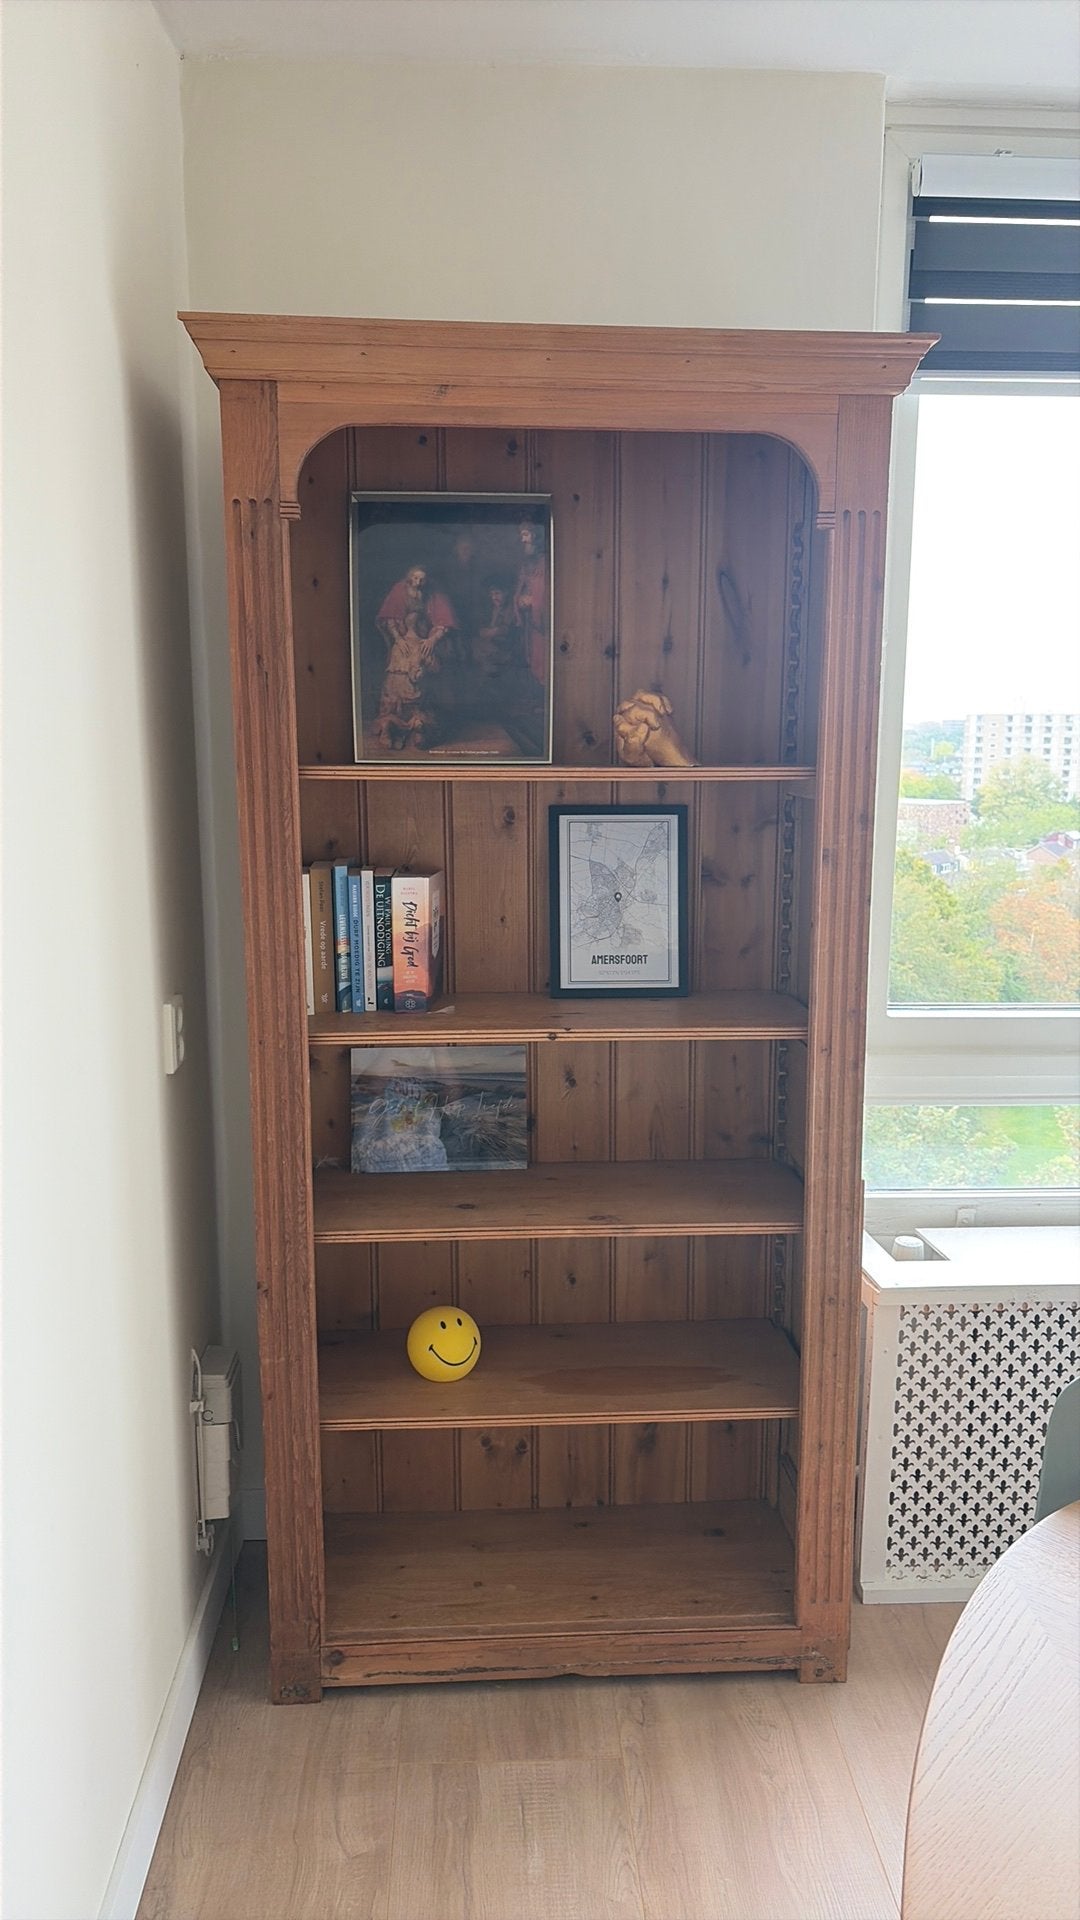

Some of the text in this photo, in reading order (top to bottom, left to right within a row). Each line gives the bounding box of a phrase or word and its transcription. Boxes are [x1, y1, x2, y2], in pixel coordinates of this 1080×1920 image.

[402, 901, 420, 929] Dicht
[375, 884, 386, 967] DE UITNODIGING
[402, 931, 419, 943] bij
[319, 941, 326, 950] op
[320, 951, 328, 969] aarde
[400, 946, 420, 968] God
[591, 954, 648, 965] AMERSFOORT
[355, 968, 361, 977] TE
